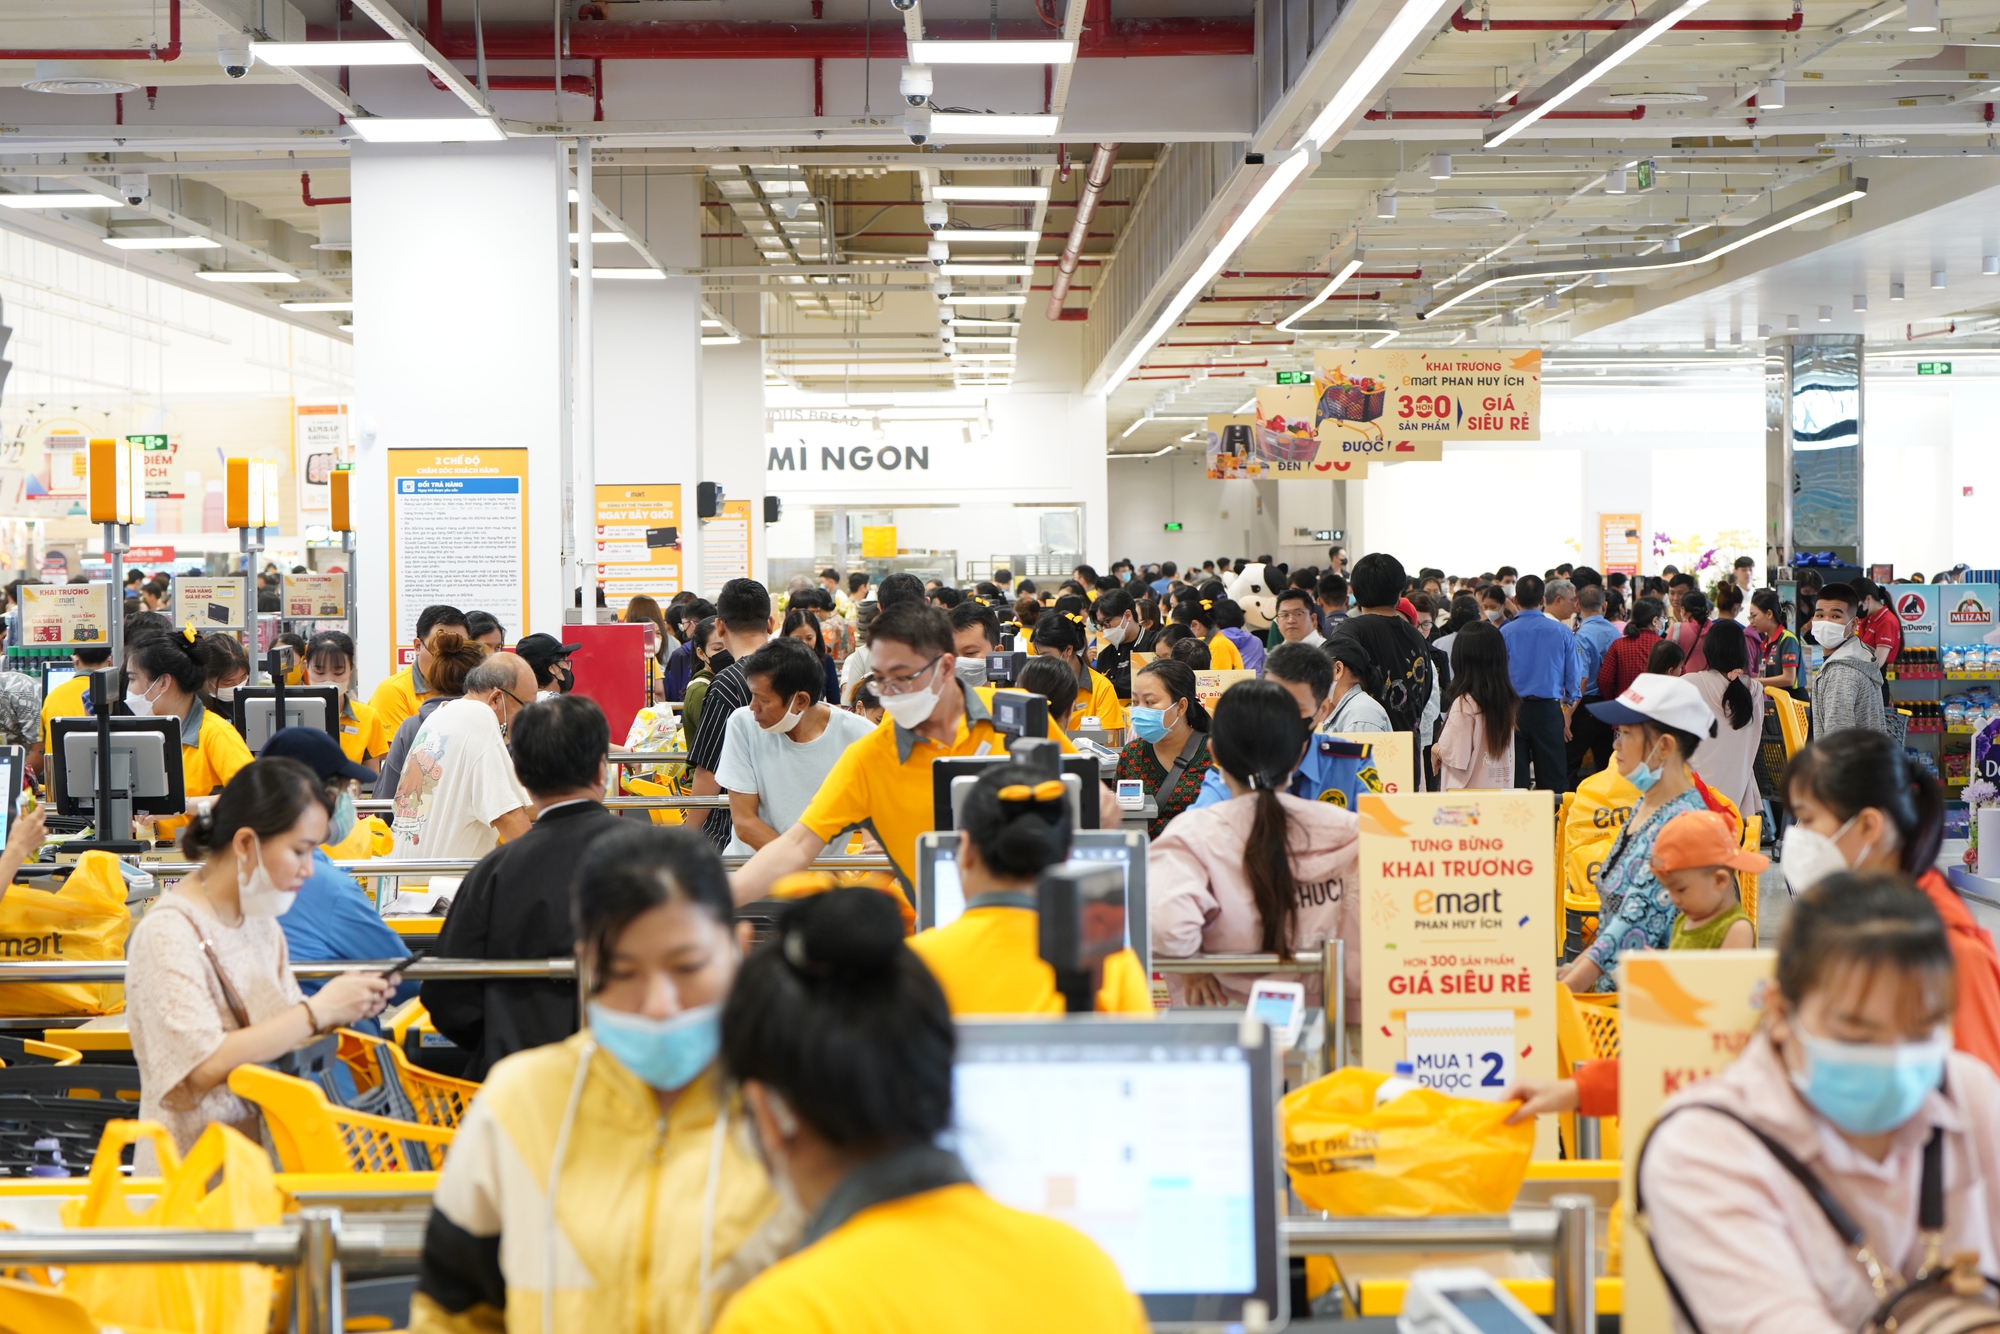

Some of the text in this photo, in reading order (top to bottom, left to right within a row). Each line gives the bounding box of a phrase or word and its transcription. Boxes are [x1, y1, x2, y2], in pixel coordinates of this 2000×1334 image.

[1426, 361, 1502, 371] KHAI TRƯƠNG
[1402, 374, 1524, 386] emart PHAN HUY ÍCH
[1398, 395, 1451, 418] 300
[1482, 393, 1515, 411] GIÁ
[1399, 419, 1450, 431] SẢN PHẨM
[1467, 412, 1529, 431] SIÊU RẺ
[767, 438, 928, 471] MÌ NGON
[1342, 441, 1384, 455] ĐƯỢC
[435, 454, 480, 467] 2 CHẾ ĐỘ
[598, 508, 673, 520] NGAY BÂY GIỜ!
[1952, 613, 1989, 621] MEIZAN
[1410, 835, 1504, 852] TƯNG BỪNG
[1382, 858, 1533, 878] KHAI TRƯƠNG
[1413, 888, 1502, 915] emart
[1415, 917, 1502, 929] PHAN HUY ÍCH
[1403, 954, 1514, 967] HƠN 300 SẢN PHẨM
[1388, 967, 1531, 995] GIÁ SIÊU RẺ
[1417, 1054, 1473, 1069] MUA 1
[1418, 1052, 1504, 1091] ĐƯỢC 2
